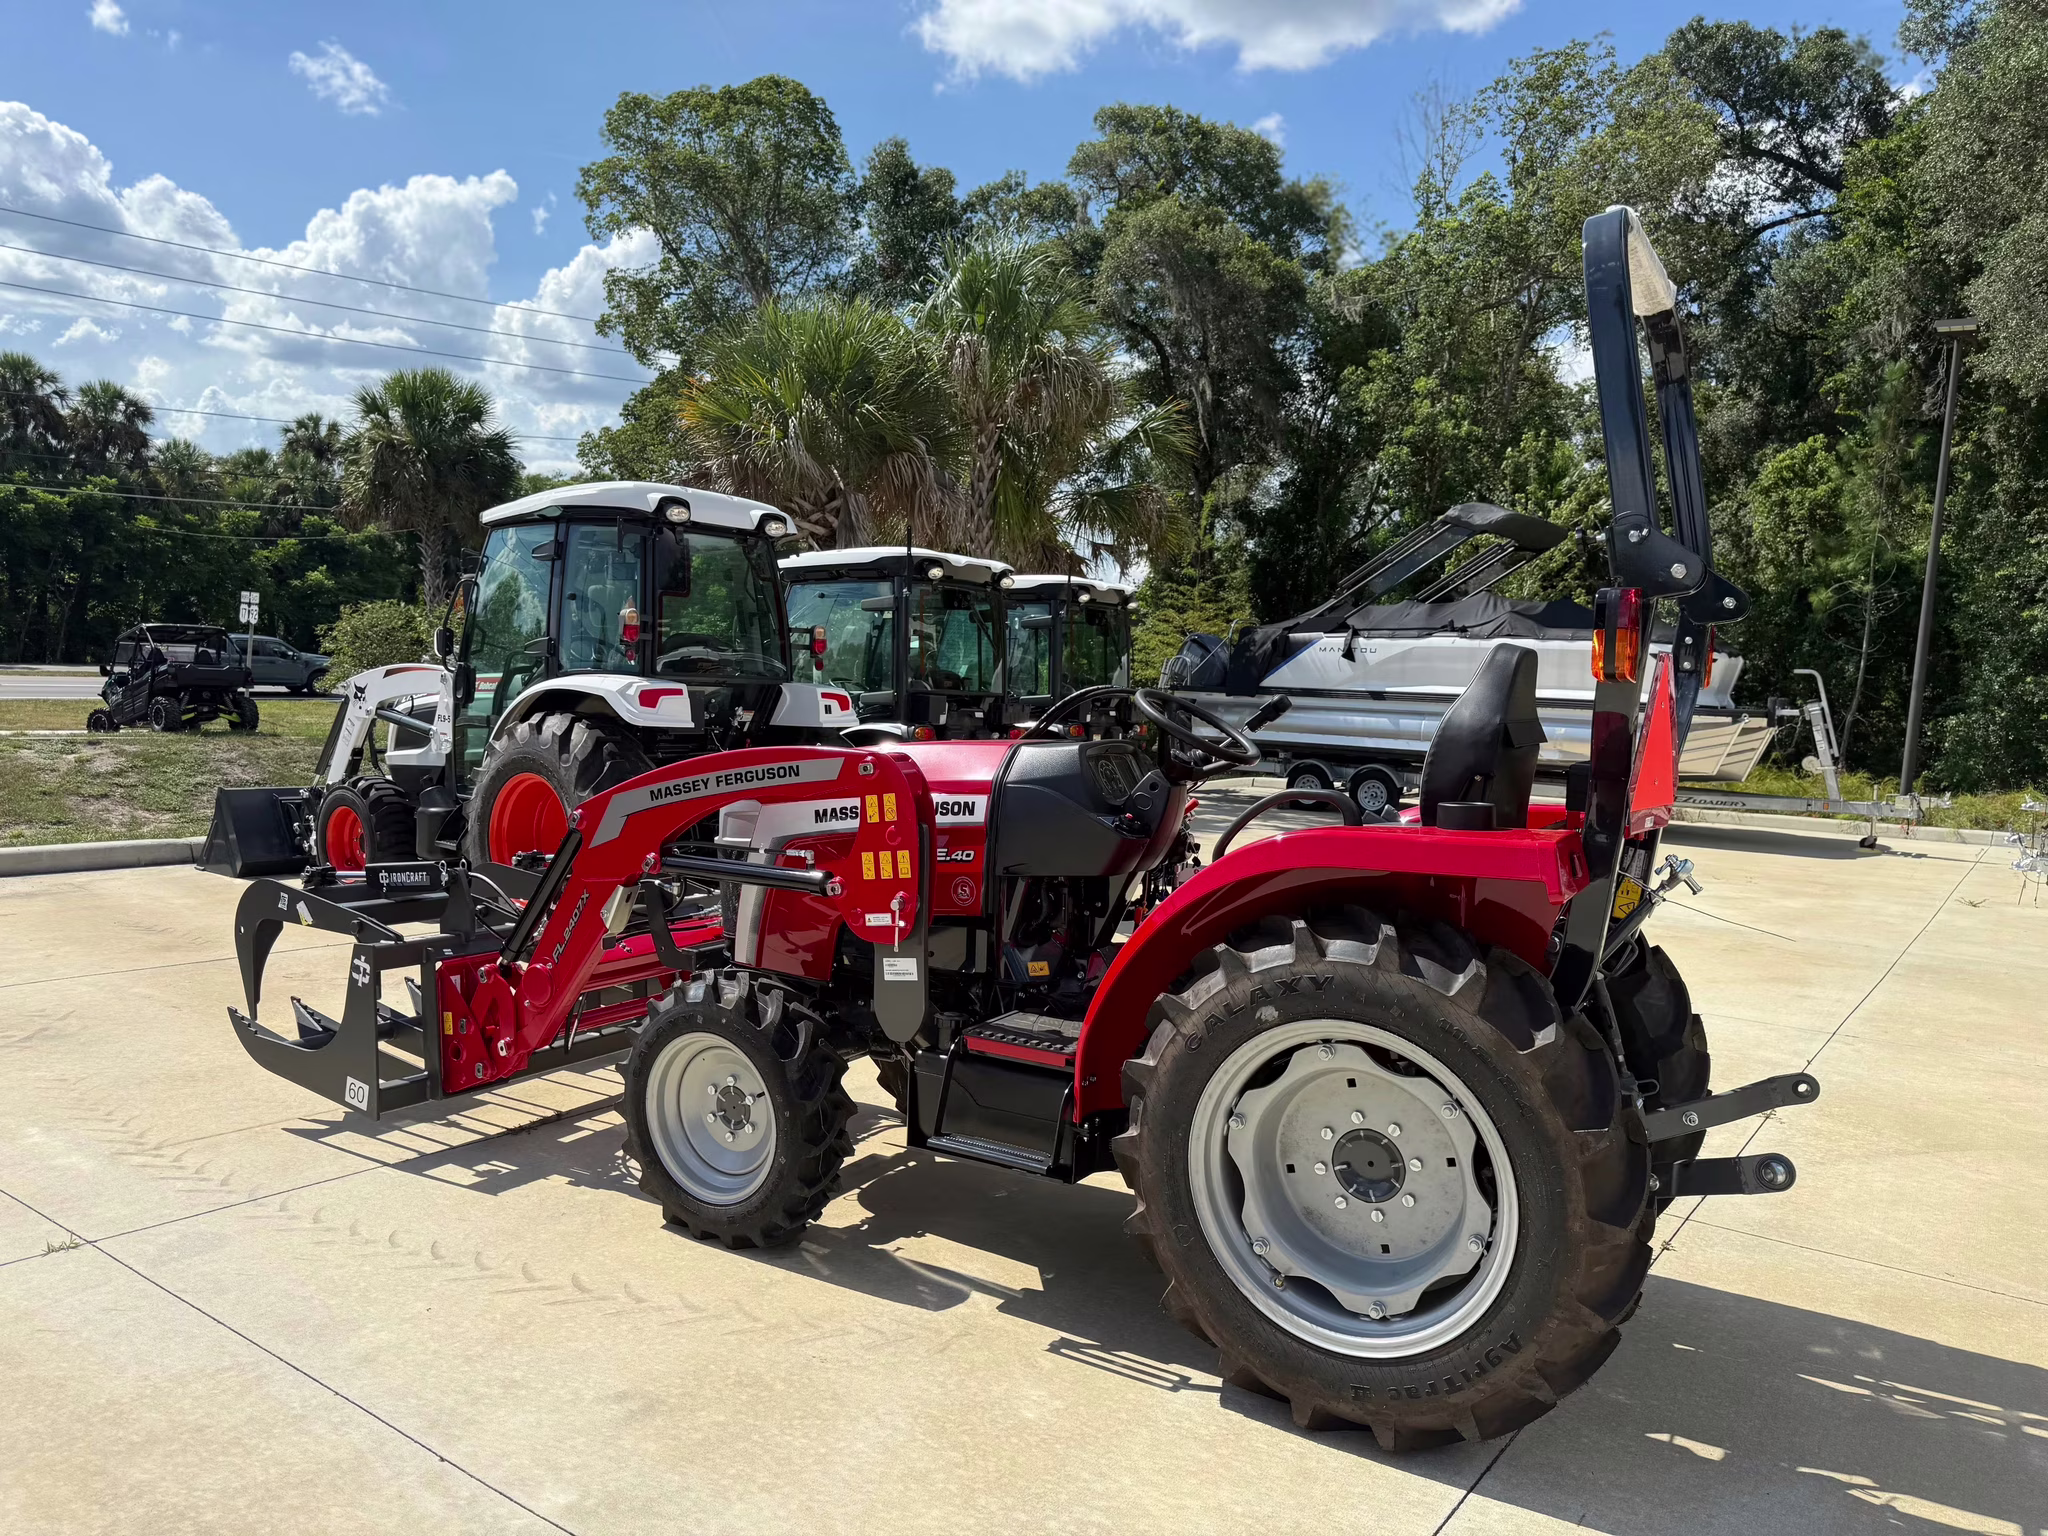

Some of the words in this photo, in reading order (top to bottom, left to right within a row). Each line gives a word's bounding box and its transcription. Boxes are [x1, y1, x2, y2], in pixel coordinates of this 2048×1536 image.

[1319, 646, 1377, 654] MANTOU
[650, 778, 710, 802] MASSEY
[716, 765, 800, 788] FERGUSON
[814, 805, 859, 824] MASS
[1184, 974, 1334, 1053] GALAXY
[348, 1082, 365, 1104] 60
